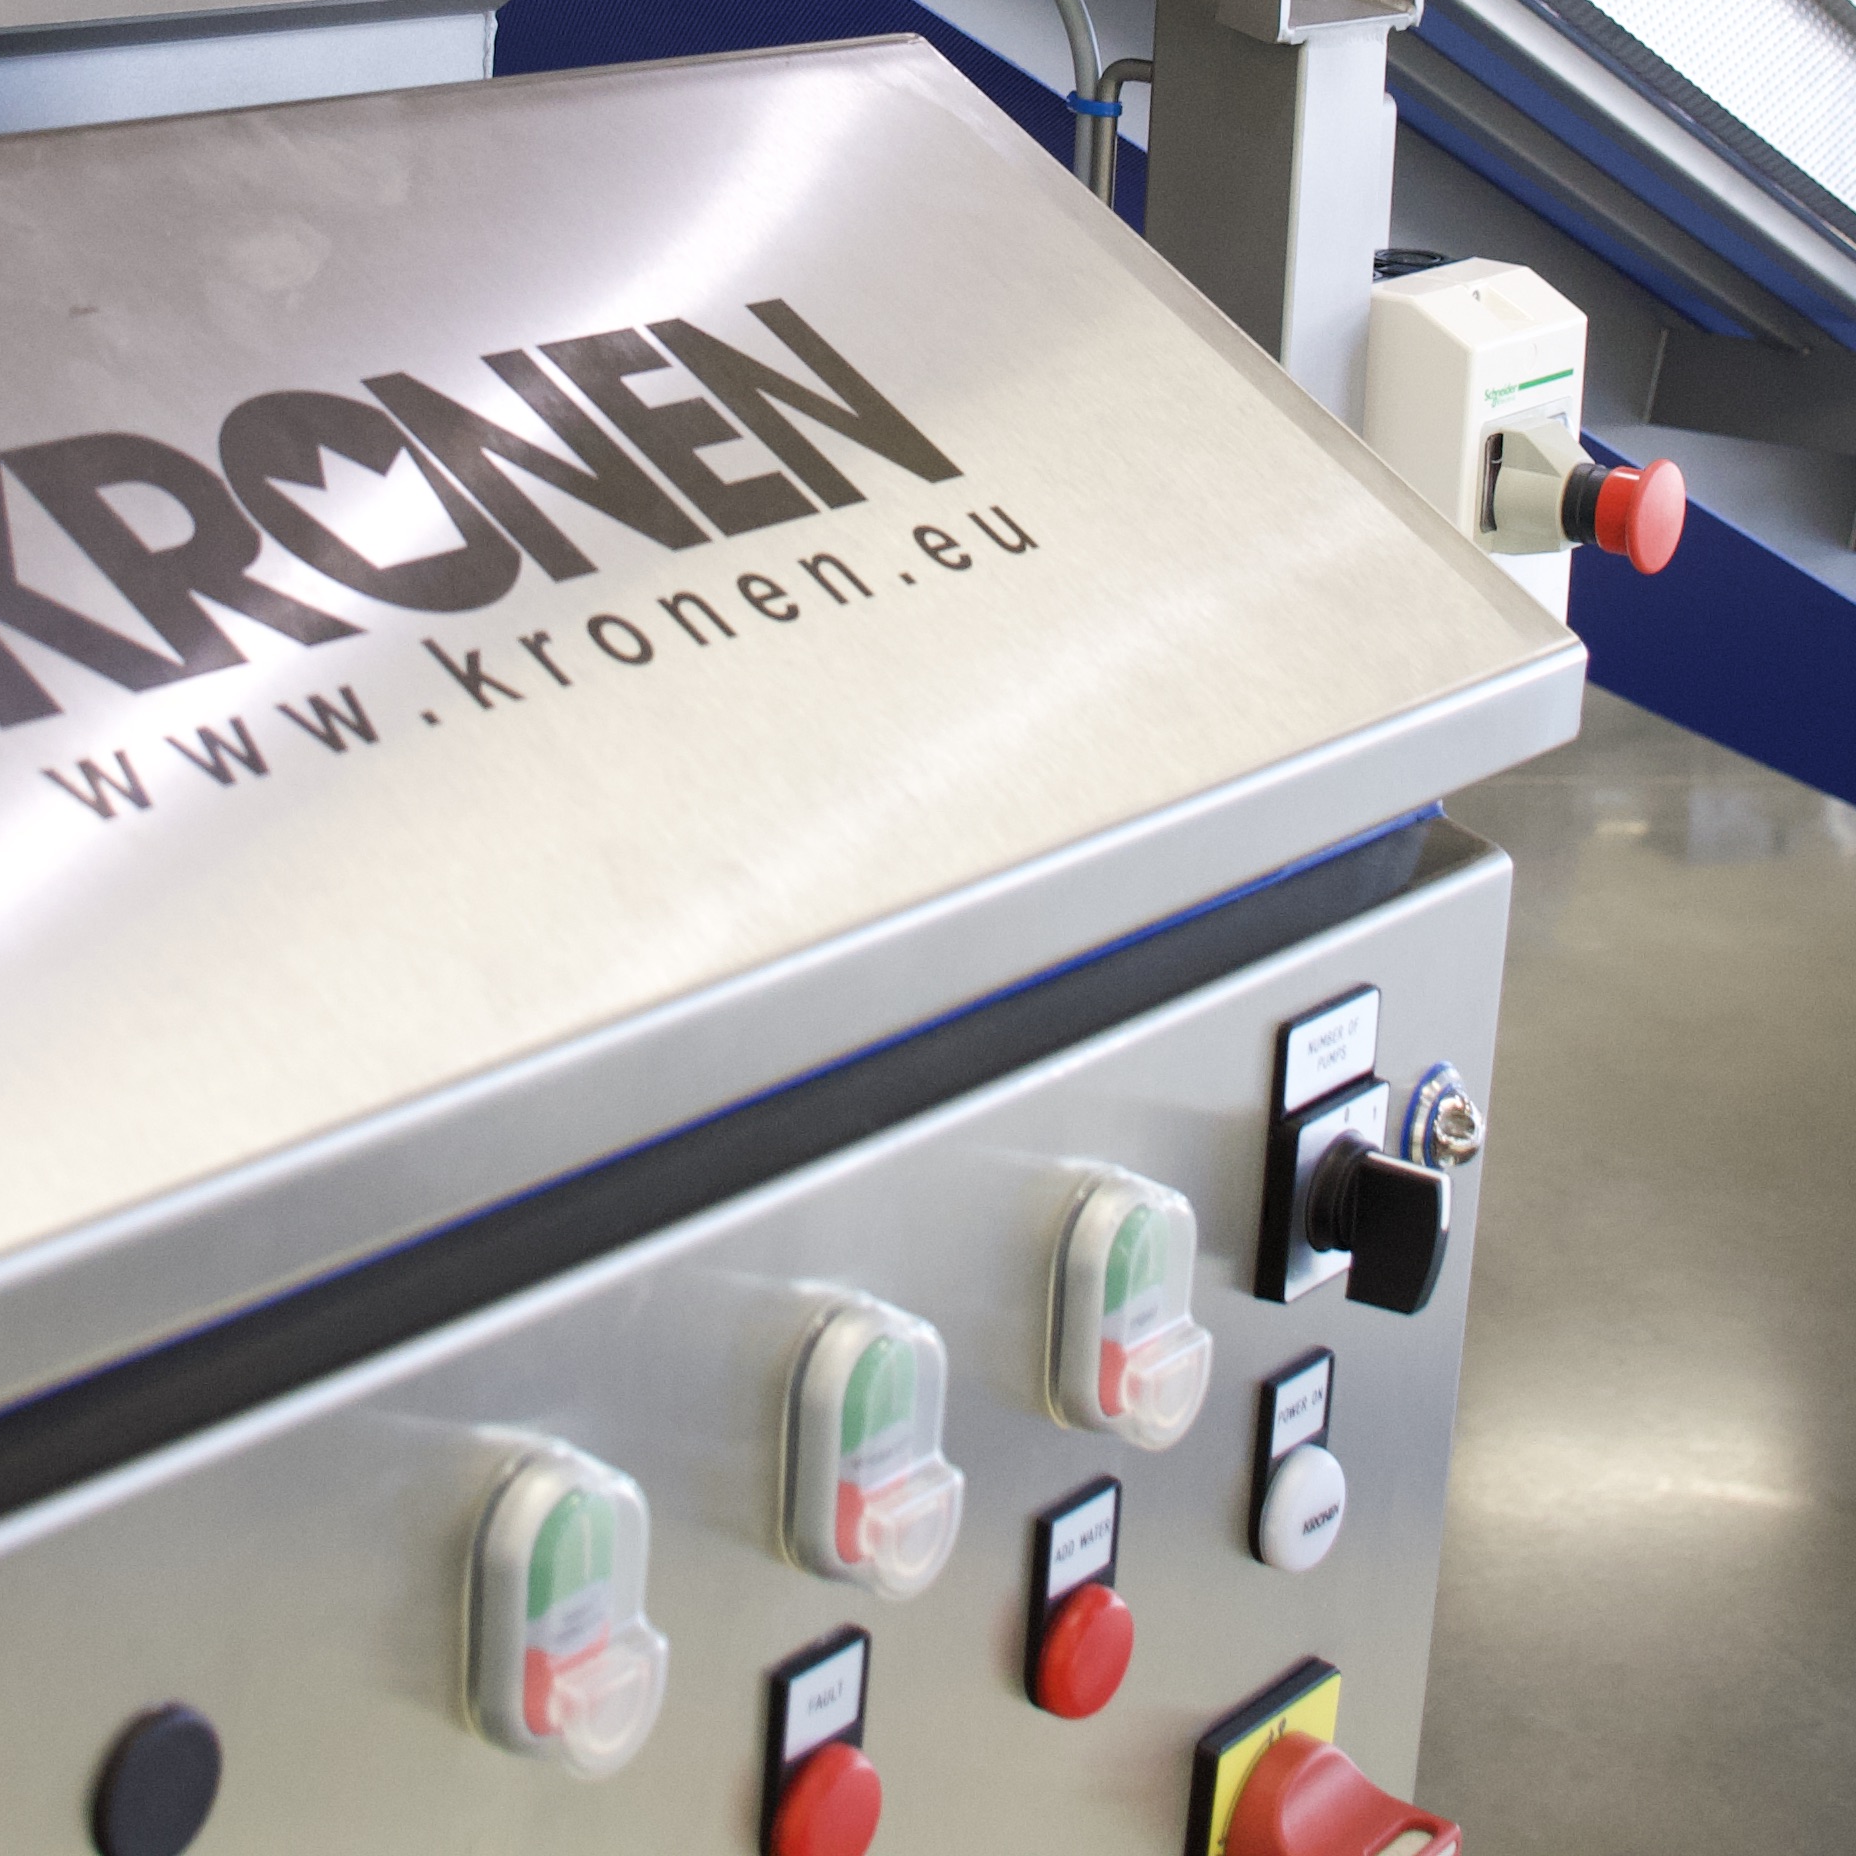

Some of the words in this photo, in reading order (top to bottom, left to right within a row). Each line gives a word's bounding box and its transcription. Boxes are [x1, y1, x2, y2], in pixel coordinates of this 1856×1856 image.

[1484, 383, 1518, 408] Schneider
[41, 500, 1040, 820] www.kronen.eu
[1307, 1024, 1344, 1056] NUMBER
[1348, 1016, 1360, 1036] OF
[1317, 1044, 1347, 1071] PUMPS
[1277, 1396, 1308, 1425] POWER
[1312, 1386, 1324, 1406] ON
[1302, 1500, 1340, 1536] KRONEN
[1055, 1539, 1075, 1562] ADD
[1080, 1516, 1111, 1550] WATER
[808, 1678, 844, 1717] FAULT
